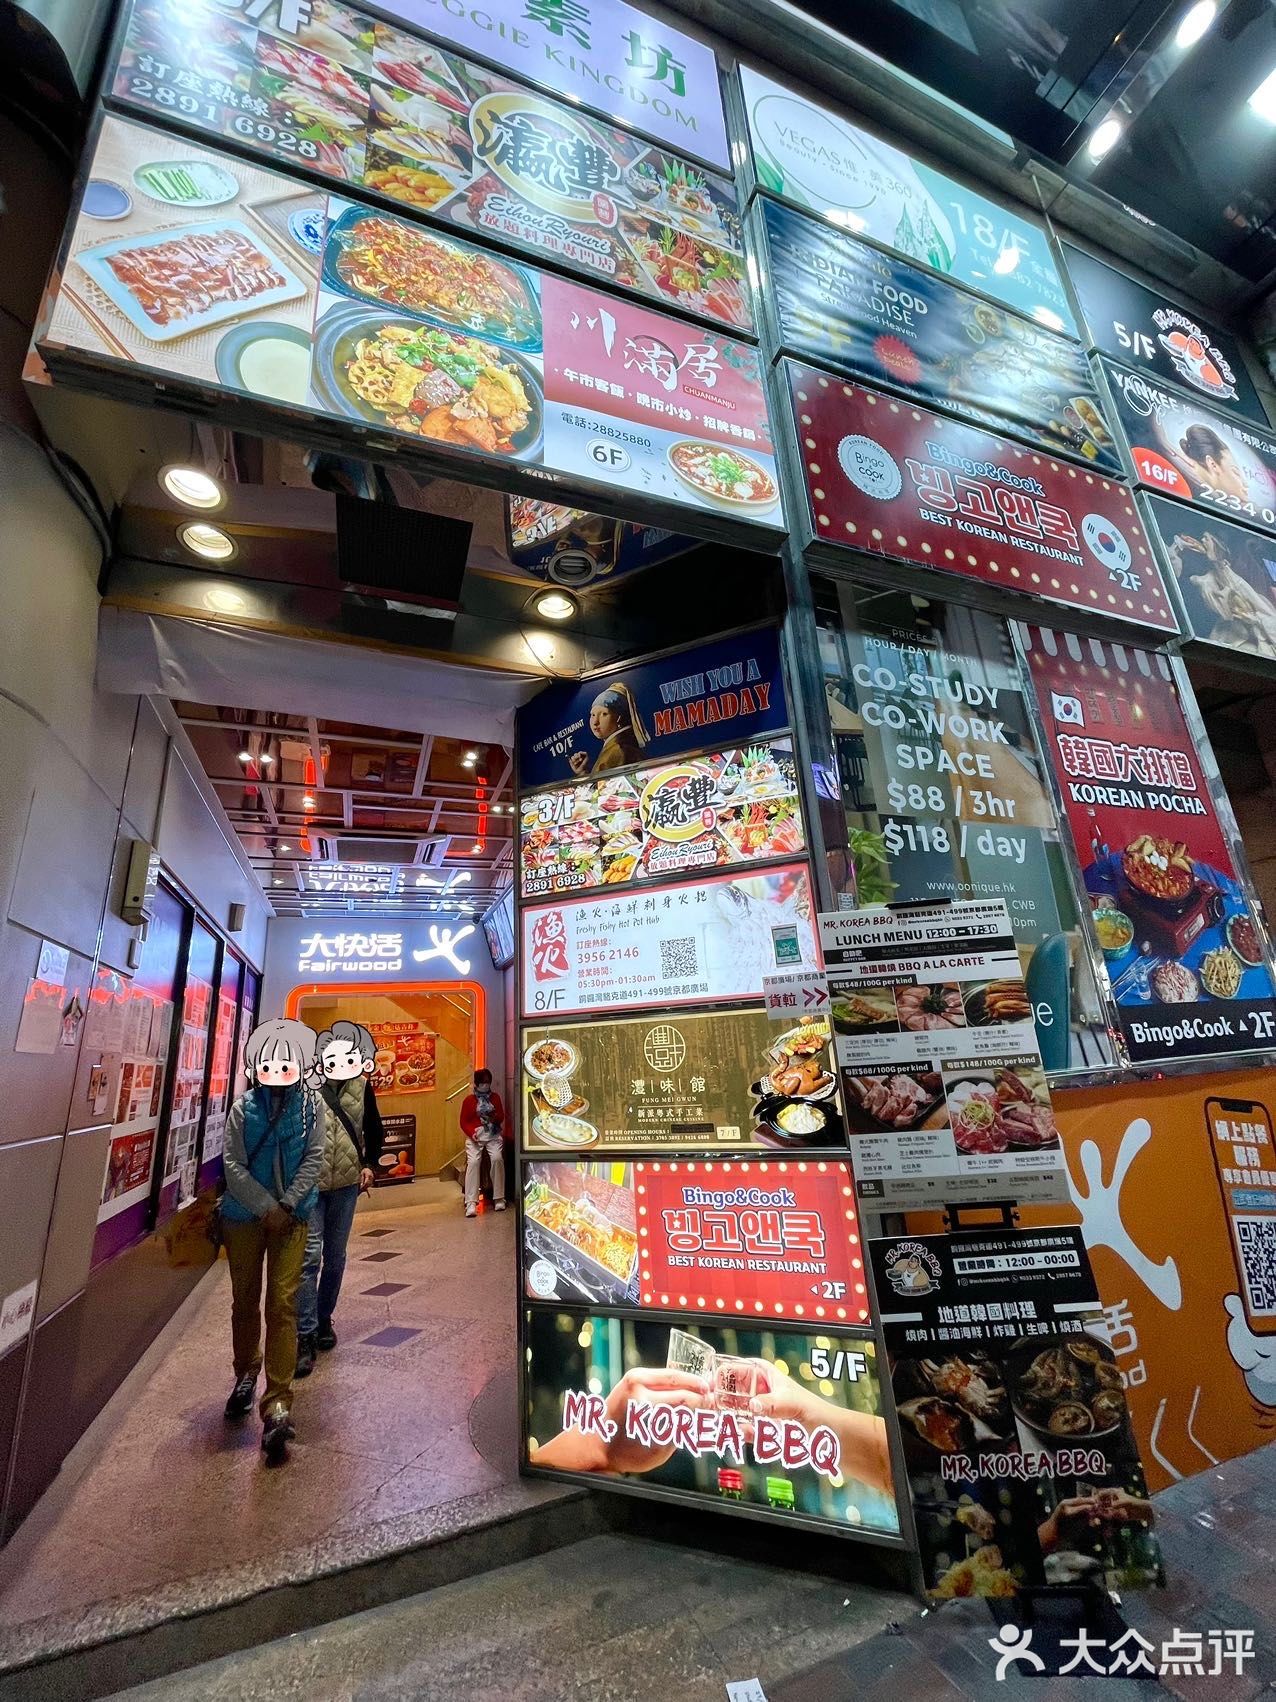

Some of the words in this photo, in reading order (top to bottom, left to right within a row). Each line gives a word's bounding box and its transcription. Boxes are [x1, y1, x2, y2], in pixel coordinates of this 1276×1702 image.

[545, 44, 698, 133] KINGDOM
[131, 78, 218, 123] 2891
[235, 117, 317, 158] 6928
[774, 121, 841, 166] VEGAS
[950, 202, 1030, 256] 18/F
[872, 279, 928, 316] FOOD
[883, 316, 917, 339] Heaven
[570, 308, 723, 392] 川滿居
[1113, 321, 1157, 360] 5/F
[563, 368, 625, 399] 午市客飯
[637, 392, 692, 421] 晚市小炒
[684, 386, 736, 409] CHUANMANJU
[1111, 370, 1179, 409] YANKEE
[592, 445, 623, 466] 6F
[855, 451, 885, 468] Bingo
[925, 441, 1046, 497] Bingo&Cook
[1142, 460, 1178, 485] 16/F
[905, 458, 1080, 551] 빙고앤쿡
[1200, 484, 1256, 517] 2234
[918, 508, 953, 529] BEST
[957, 519, 1009, 545] KOREAN
[1010, 534, 1084, 567] RESTAURANT
[1114, 569, 1142, 592] 2F
[865, 637, 896, 651] HOUR
[907, 645, 930, 658] DAY
[892, 628, 929, 643] PRICES
[659, 673, 706, 704] WISH
[706, 662, 744, 691] YOU
[747, 658, 762, 681] A
[852, 663, 999, 710] CO-STUDY
[653, 683, 771, 737] MAMADAY
[557, 718, 585, 740] RESTAURANT
[861, 701, 1009, 746] CO-WORK
[549, 735, 574, 758] 10/F
[896, 744, 995, 779] SPACE
[1057, 734, 1197, 791] 韓國大排檔
[538, 793, 576, 823] 3/F
[887, 777, 946, 813] $88
[969, 790, 1015, 819] 3hr
[1068, 782, 1149, 809] KOREAN
[1150, 792, 1208, 815] POCHA
[884, 818, 950, 856] $118
[977, 829, 1026, 864] day
[527, 878, 553, 893] 2891
[557, 874, 586, 887] 6928
[927, 881, 1015, 894] www.oonique.hk
[1012, 900, 1036, 910] CWB
[618, 920, 630, 928] Hot
[633, 918, 644, 927] Pot
[823, 919, 838, 930] MR.
[840, 918, 870, 928] KOREA
[873, 916, 893, 926] BBQ
[300, 933, 403, 957] 大快活
[836, 932, 881, 947] LUNCH
[884, 929, 923, 943] MENU
[926, 929, 957, 940] 12:00
[967, 925, 998, 935] 17:30
[299, 959, 402, 972] Fairwood
[577, 952, 606, 964] 3956
[609, 947, 640, 961] 2146
[899, 962, 921, 971] BBQ
[923, 961, 931, 969] A
[933, 960, 947, 968] LA
[949, 957, 985, 967] CARTE
[577, 974, 656, 988] 05:30pm-01:30am
[882, 979, 895, 987] per
[896, 976, 913, 985] kind
[534, 988, 566, 1010] 8/F
[1130, 1016, 1235, 1046] Bingo&Cook
[1248, 1011, 1276, 1039] 2F
[897, 1066, 911, 1075] per
[911, 1064, 929, 1073] kind
[1004, 1058, 1018, 1067] per
[1019, 1056, 1036, 1065] kind
[682, 1187, 796, 1209] Bingo&Cook
[662, 1209, 827, 1258] 빙고앤쿡
[897, 1242, 928, 1259] KOREA
[1005, 1256, 1035, 1268] 12:00
[1044, 1253, 1075, 1264] 00:00
[668, 1255, 697, 1268] BEST
[698, 1256, 744, 1270] KOREAN
[747, 1258, 827, 1275] RESTAURANT
[821, 1281, 846, 1300] 2F
[937, 1301, 1037, 1323] 地道韓國料理
[811, 1348, 867, 1382] 5/F
[563, 1390, 618, 1443] MR.
[626, 1398, 745, 1465] KOREA
[753, 1415, 843, 1481] BBQ
[941, 1454, 978, 1483] MR.
[979, 1452, 1055, 1482] KOREA
[1056, 1448, 1107, 1476] BBQ
